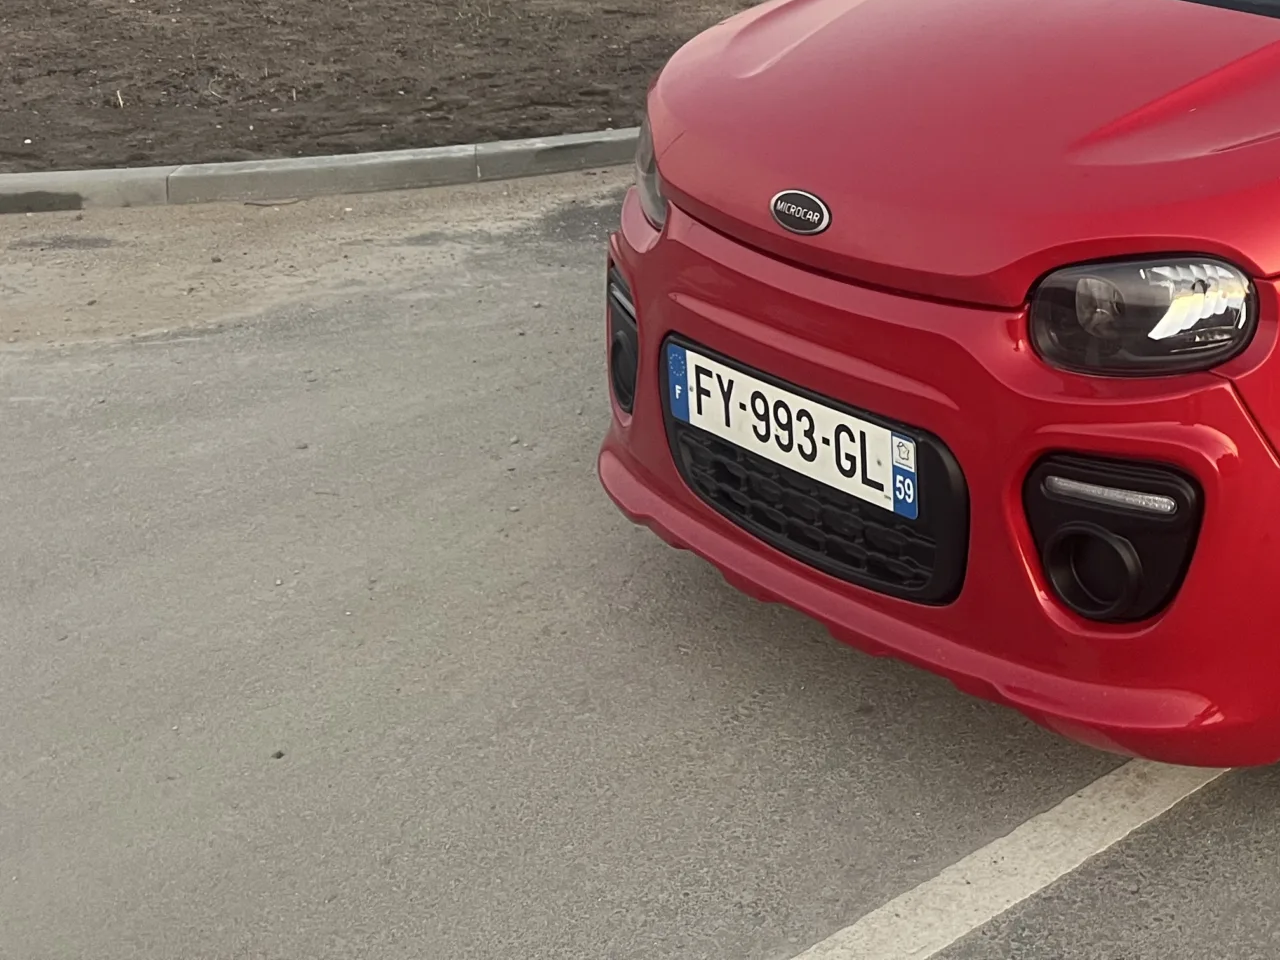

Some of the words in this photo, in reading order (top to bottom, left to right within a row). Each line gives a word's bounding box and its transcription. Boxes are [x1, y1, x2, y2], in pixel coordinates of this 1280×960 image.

[776, 199, 820, 224] MICROCAR
[674, 384, 682, 400] F
[694, 364, 885, 492] FY-993-GL
[895, 474, 914, 504] 59
